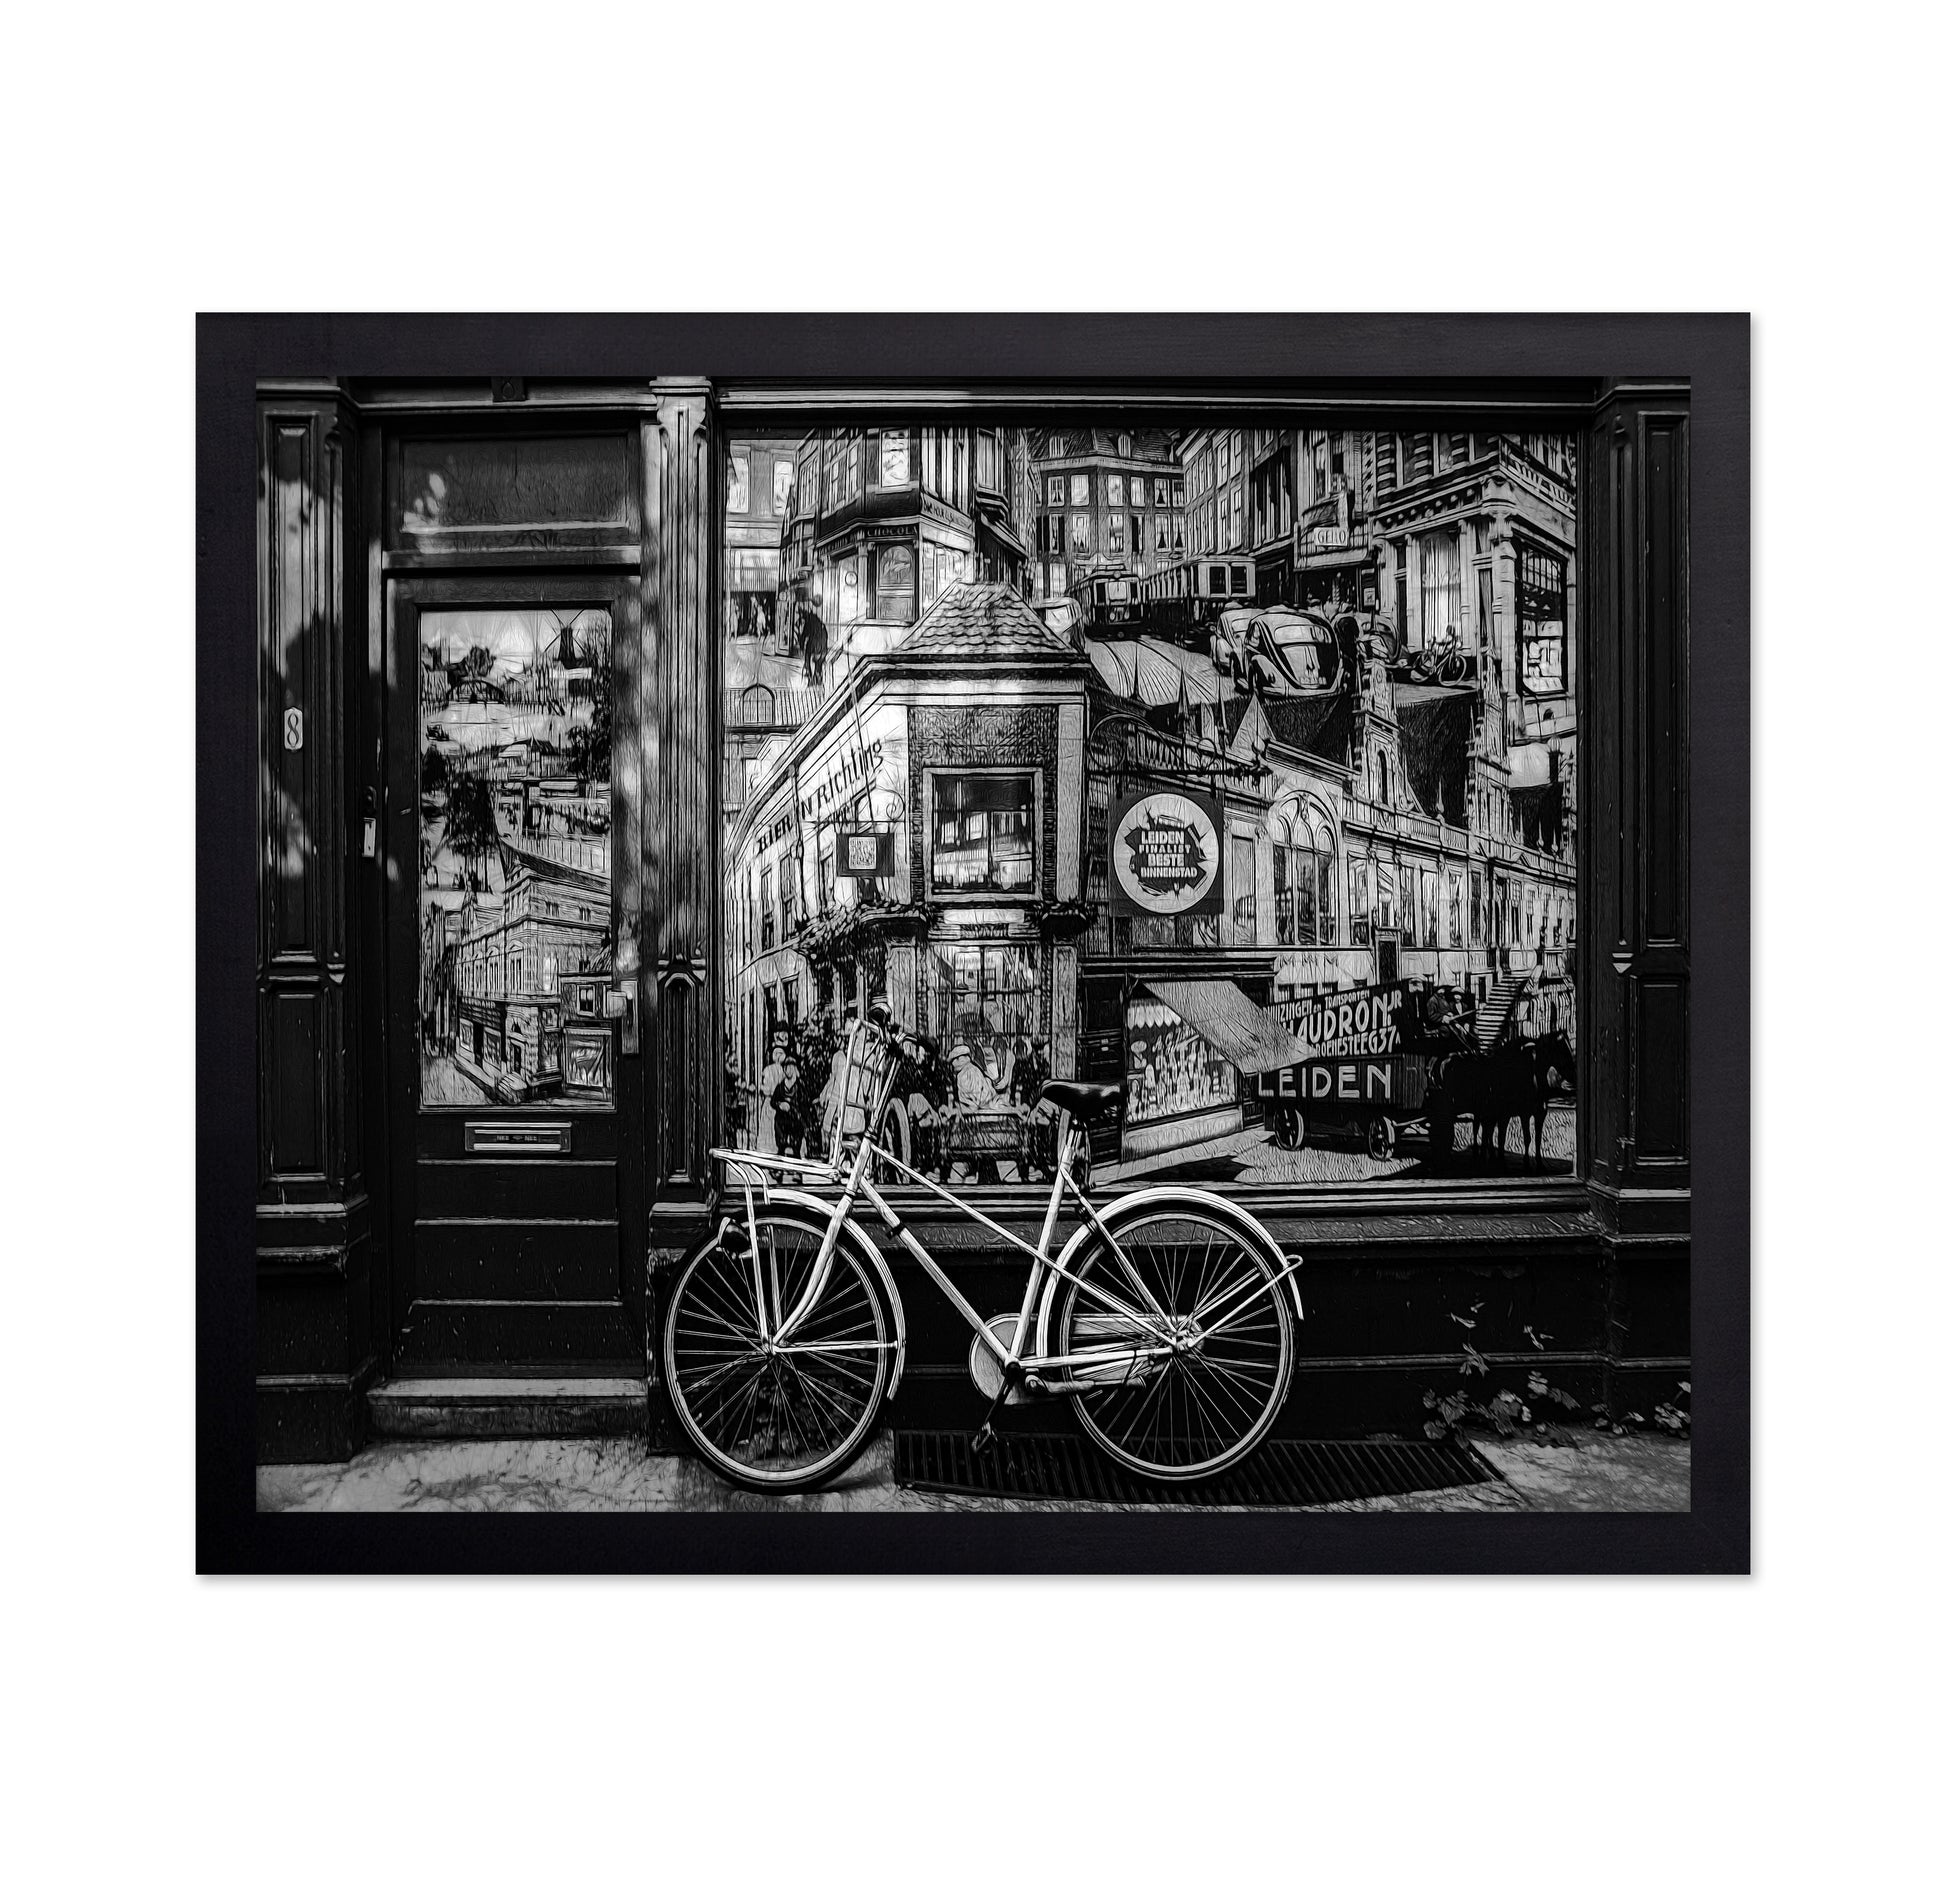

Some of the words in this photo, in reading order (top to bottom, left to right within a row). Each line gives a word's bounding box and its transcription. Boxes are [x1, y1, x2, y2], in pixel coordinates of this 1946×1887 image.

[287, 712, 300, 749] 8
[1141, 830, 1185, 844] LEIDEN
[1139, 844, 1191, 854] FINALIST
[1147, 853, 1185, 867] BESTE
[1140, 867, 1198, 878] BINNENSTAD
[1324, 989, 1370, 1010] TRANSPORTEN
[1312, 1030, 1378, 1058] ROENESTEEG
[1258, 1064, 1391, 1099] LEIDEN
